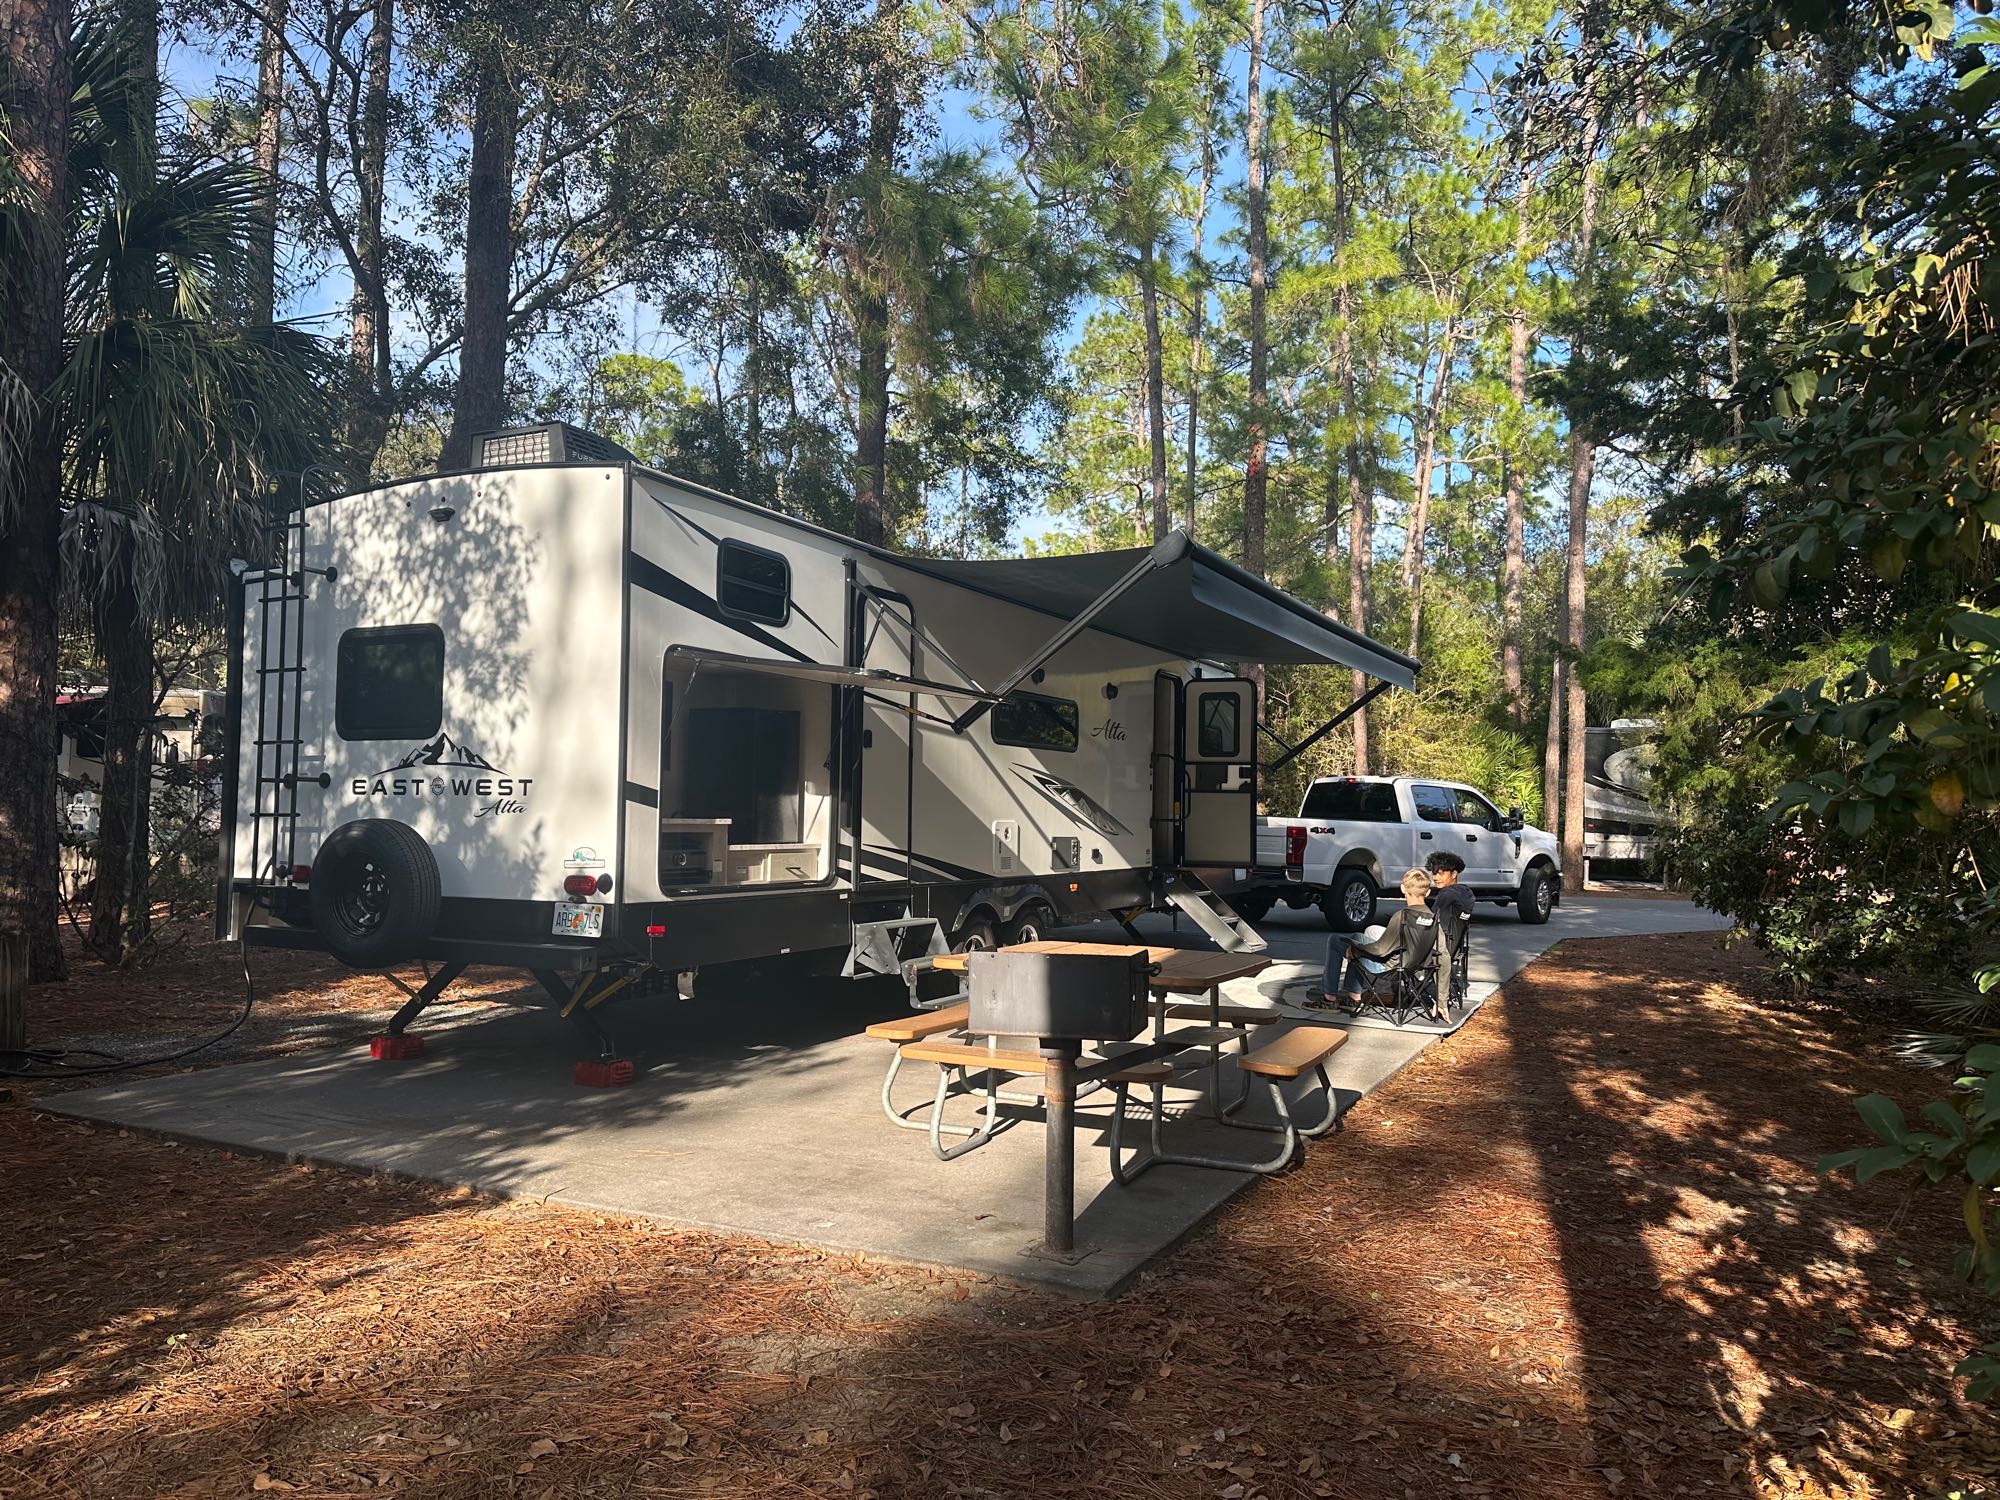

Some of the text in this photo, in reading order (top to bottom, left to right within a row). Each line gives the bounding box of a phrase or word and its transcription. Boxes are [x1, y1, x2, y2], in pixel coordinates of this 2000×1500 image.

[1090, 718, 1128, 741] Alta
[352, 779, 425, 796] EAST
[451, 779, 533, 796] WEST
[474, 798, 530, 818] Alta
